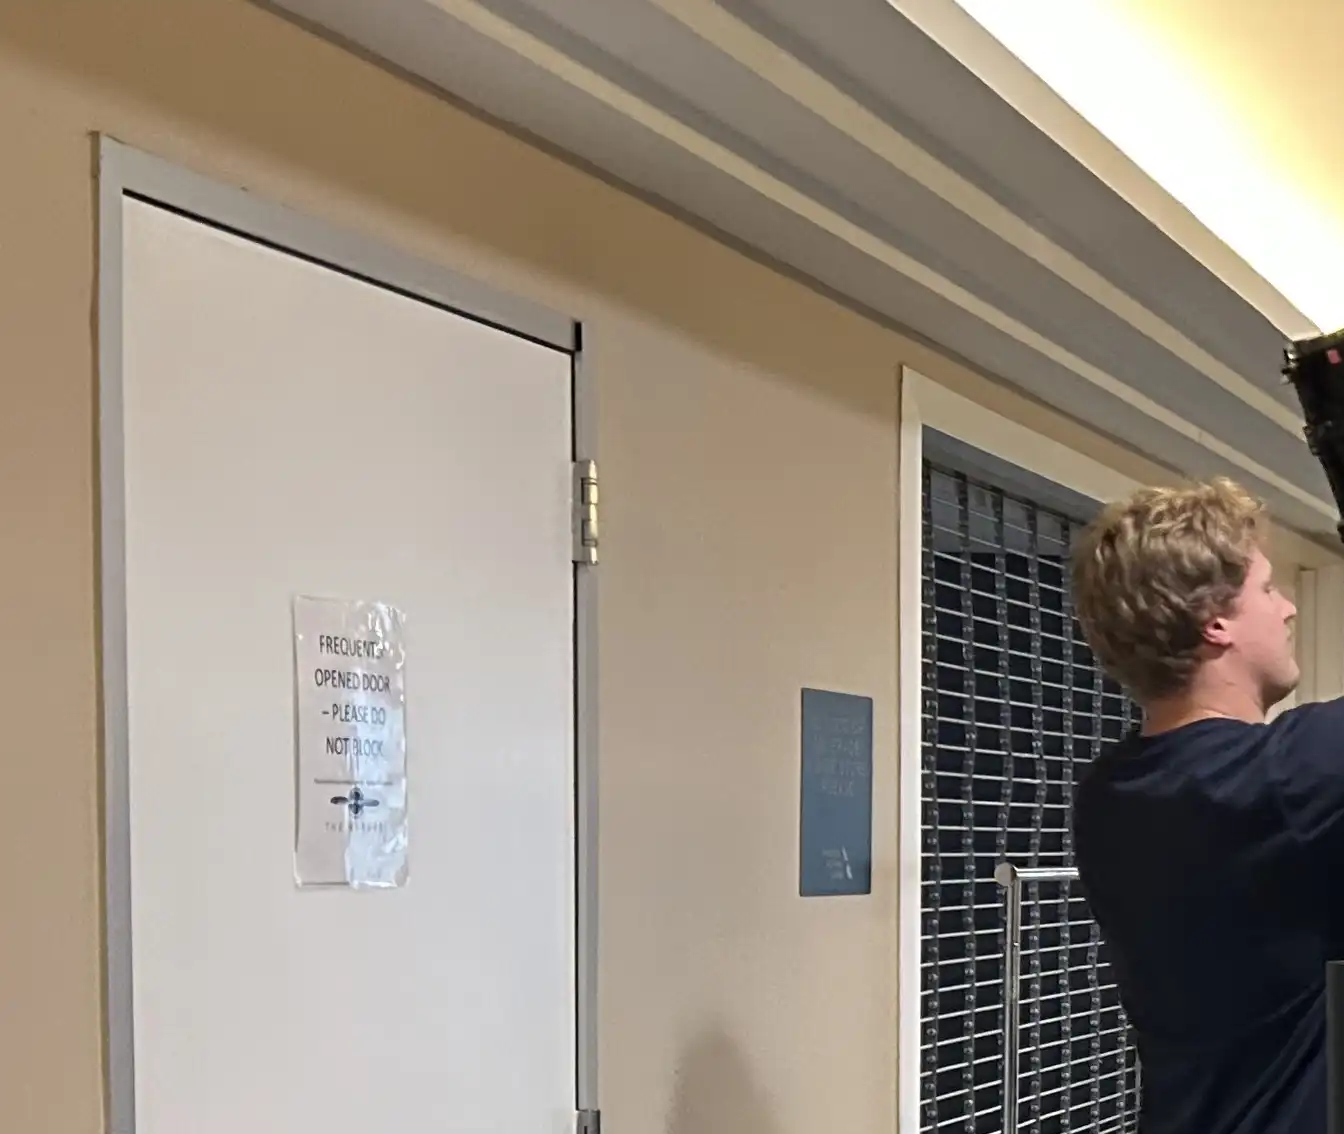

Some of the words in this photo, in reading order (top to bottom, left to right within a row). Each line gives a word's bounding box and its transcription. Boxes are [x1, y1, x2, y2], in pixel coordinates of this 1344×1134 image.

[314, 667, 361, 690] OPENED
[362, 674, 391, 693] DOOR
[332, 703, 369, 723] PLEASE
[371, 707, 387, 726] DO
[326, 736, 350, 756] NOT
